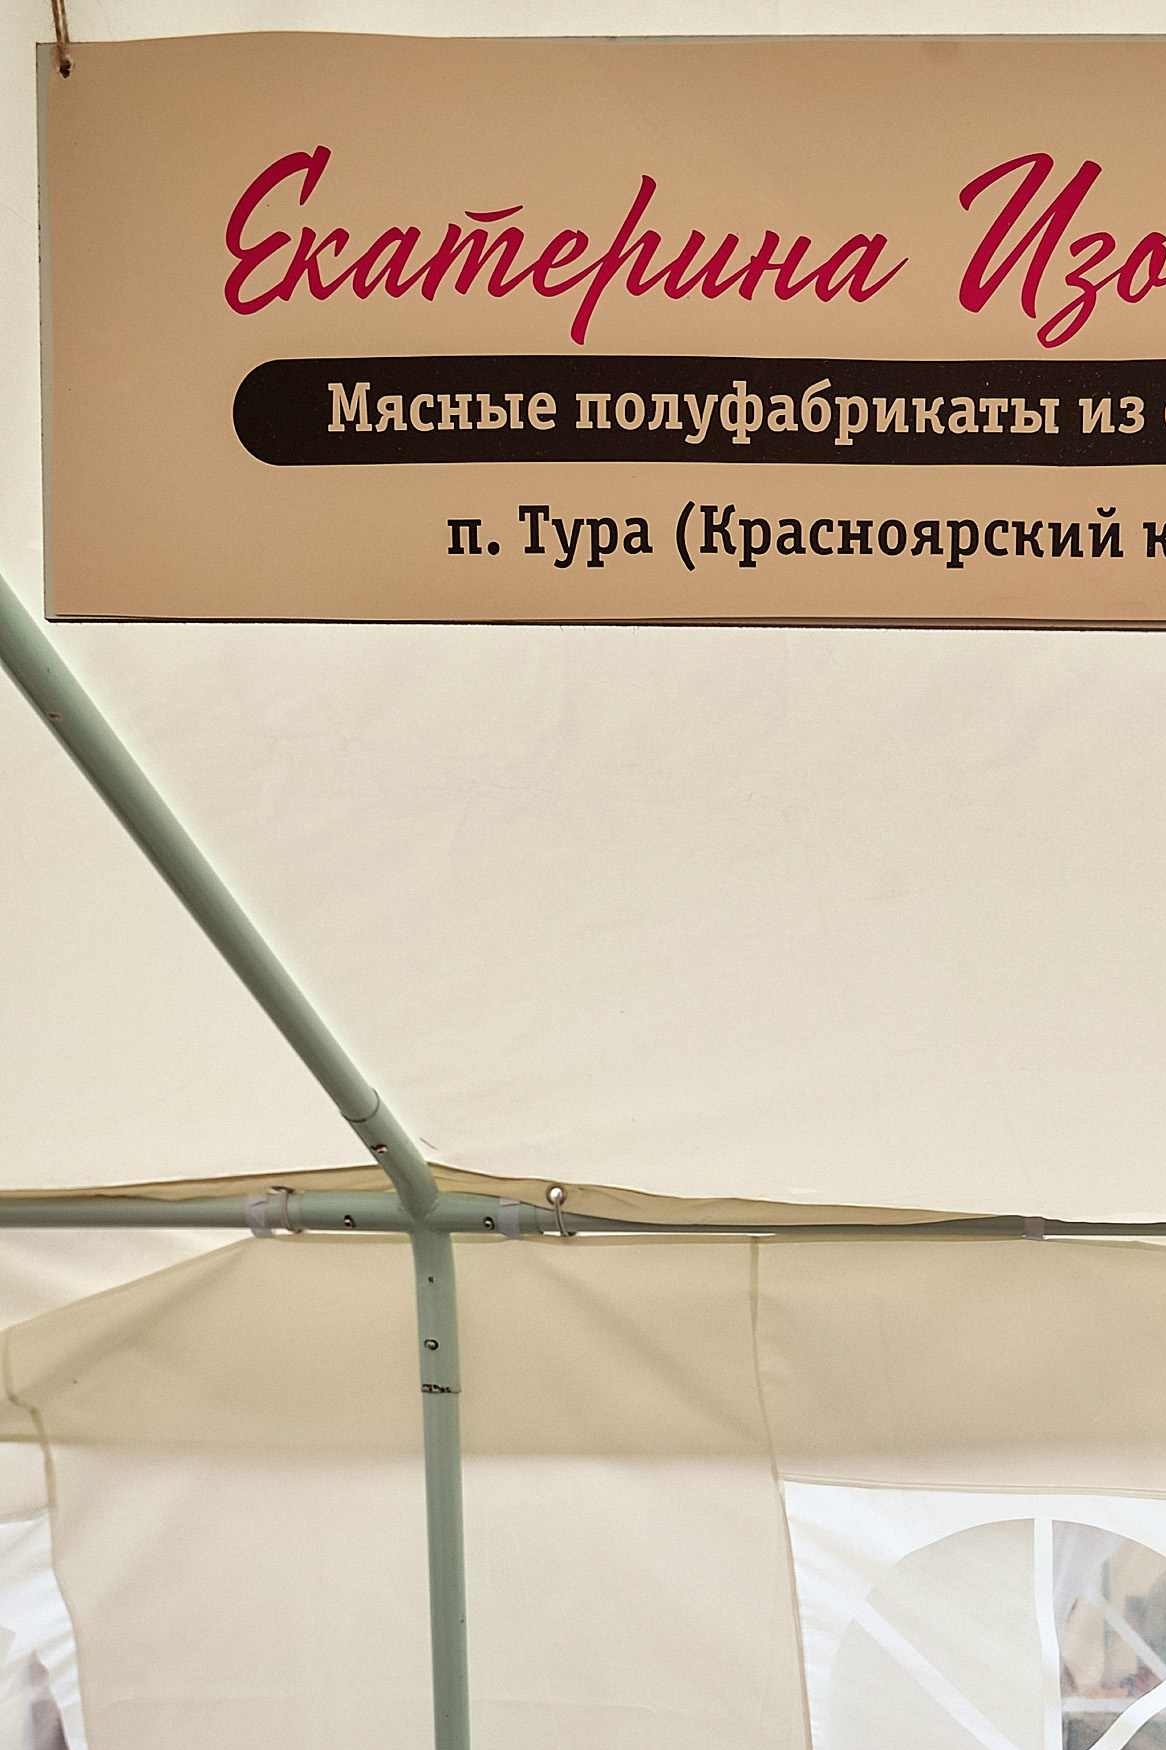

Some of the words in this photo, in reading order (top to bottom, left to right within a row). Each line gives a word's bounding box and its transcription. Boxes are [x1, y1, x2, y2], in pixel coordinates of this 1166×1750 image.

[225, 146, 905, 346] Екатерина
[328, 382, 558, 434] Мясные
[576, 379, 1061, 447] полуфабрикаты
[1079, 397, 1146, 435] из
[448, 519, 501, 557] п.
[519, 505, 655, 570] Тура
[676, 501, 1125, 573] (Красноярский
